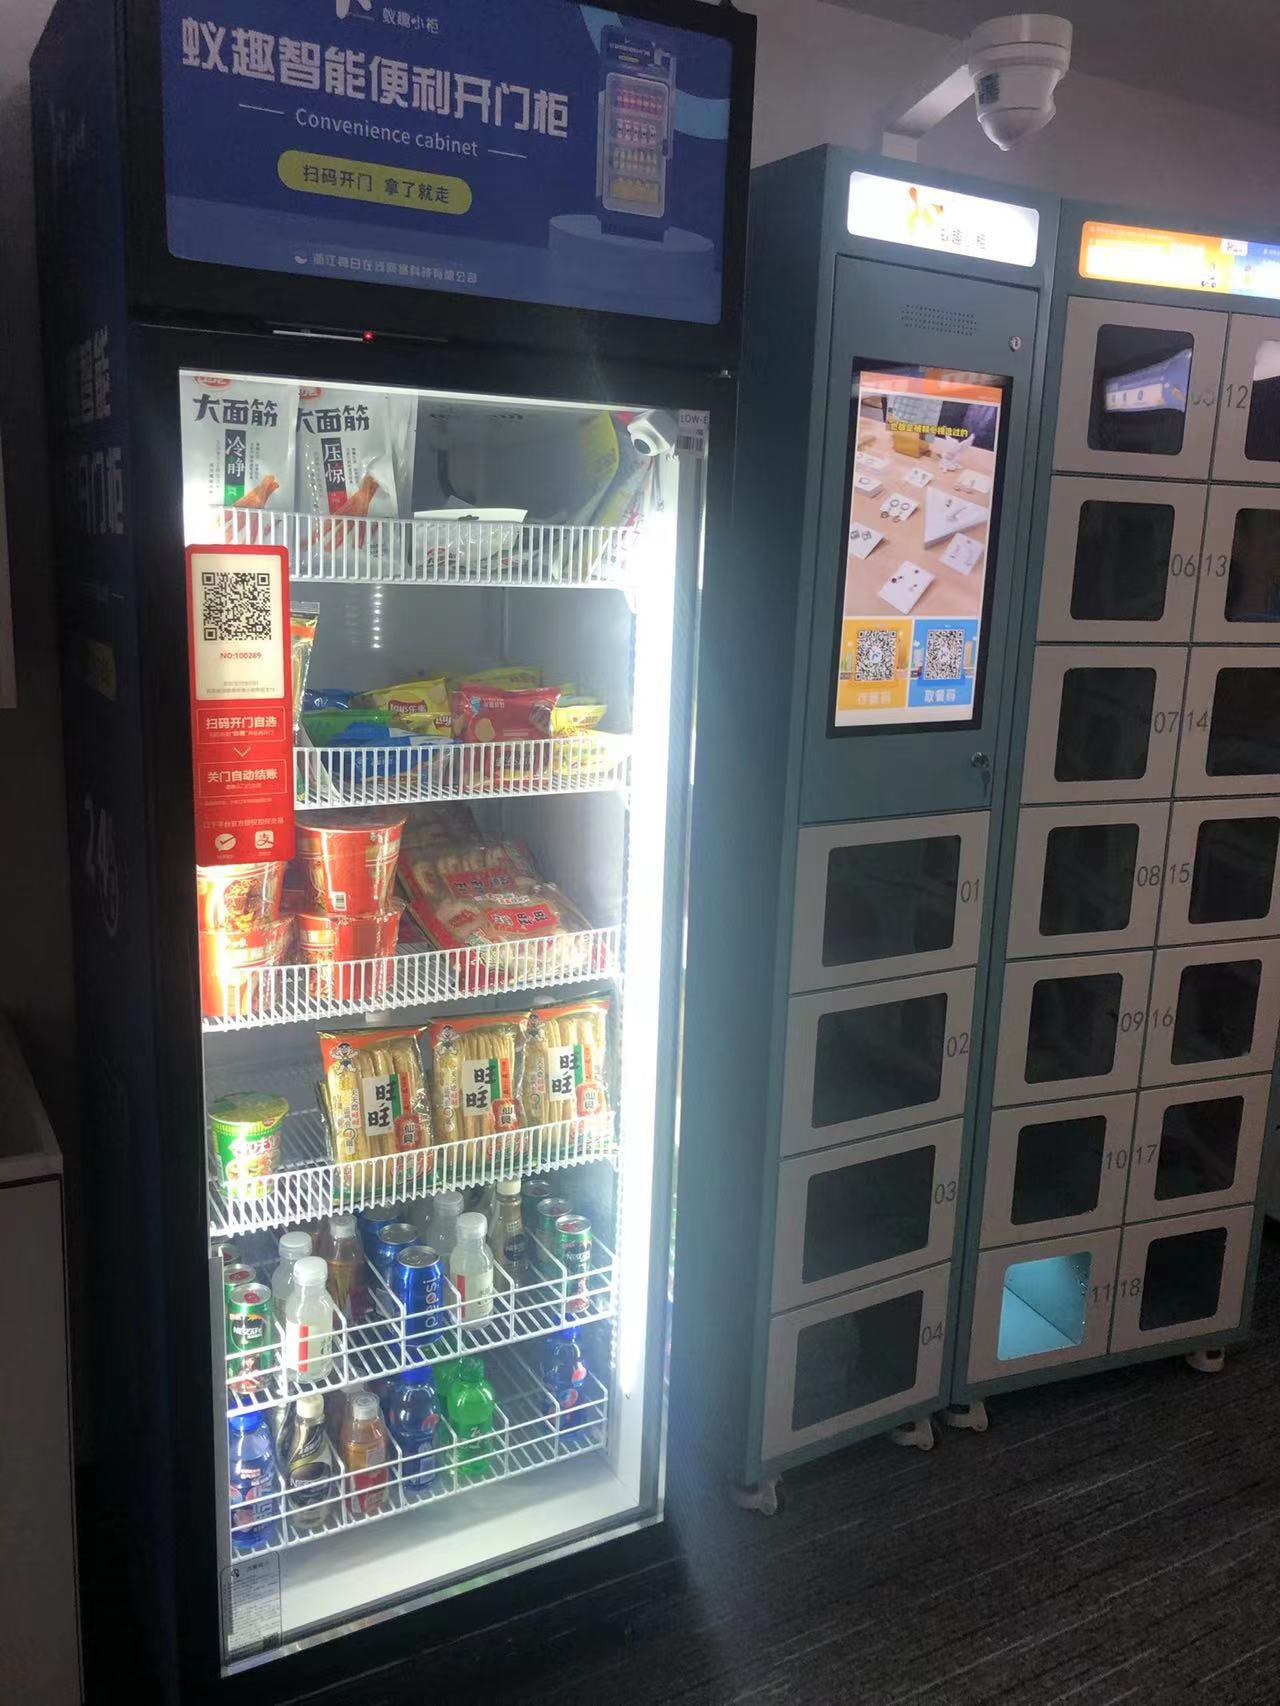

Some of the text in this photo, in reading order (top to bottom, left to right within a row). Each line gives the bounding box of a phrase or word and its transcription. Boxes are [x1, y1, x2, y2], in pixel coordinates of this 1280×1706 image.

[181, 16, 569, 138] 蚁趣智能便利开门柜
[295, 108, 478, 157] Convenience cabinet
[303, 165, 451, 203] 扫码开门 拿了就走
[1225, 383, 1249, 410] 12
[192, 394, 279, 428] 大面筋
[1171, 554, 1196, 578] 06
[1204, 553, 1228, 578] 13
[206, 715, 277, 730] 扫码开门自选
[1153, 711, 1179, 734] 07
[1186, 710, 1209, 733] 14
[207, 767, 278, 783] 关门自动结账
[1137, 864, 1160, 888] 08
[1169, 862, 1191, 885] 15
[961, 878, 981, 904] 01
[1120, 1009, 1144, 1033] 09
[1151, 1006, 1174, 1029] 16
[946, 1032, 970, 1059] 02
[551, 1053, 579, 1094] 旺旺
[465, 1066, 496, 1109] 旺旺
[367, 1079, 397, 1127] 旺旺
[1106, 1149, 1127, 1171] 10
[1135, 1144, 1159, 1166] 17
[934, 1180, 957, 1205] 03
[1119, 1277, 1142, 1299] 18
[425, 1277, 439, 1329] pepsi
[921, 1321, 944, 1346] 04
